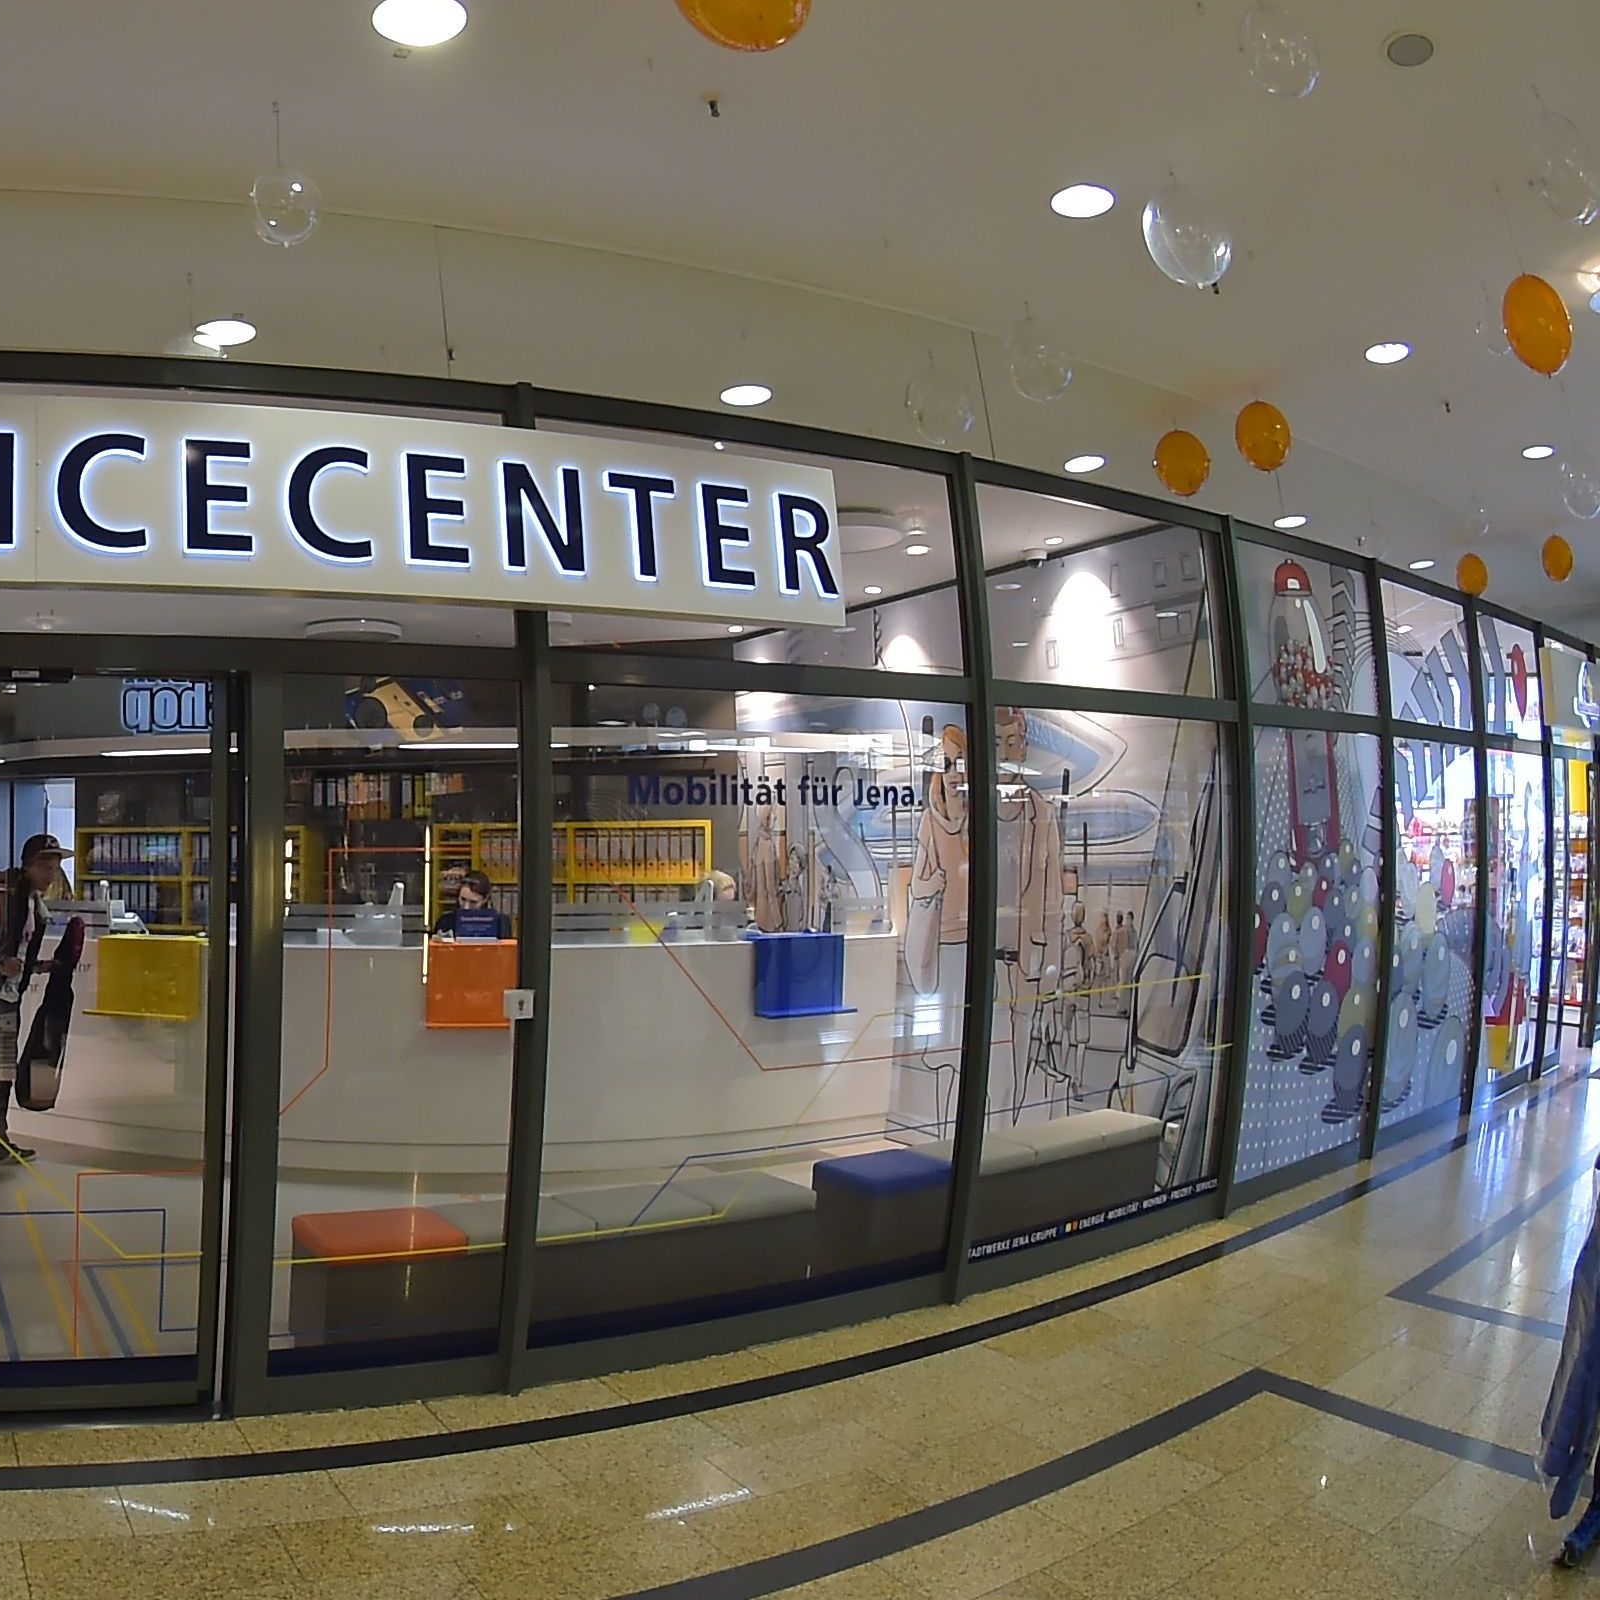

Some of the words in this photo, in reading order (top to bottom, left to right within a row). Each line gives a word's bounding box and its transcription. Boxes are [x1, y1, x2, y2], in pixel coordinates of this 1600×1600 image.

[627, 774, 787, 807] Mobilität
[798, 775, 843, 806] für
[853, 777, 923, 807] Jena.
[967, 1239, 1010, 1258] TADTWERKE
[1011, 1234, 1030, 1249] JENA
[1030, 1226, 1058, 1243] GRUPPE
